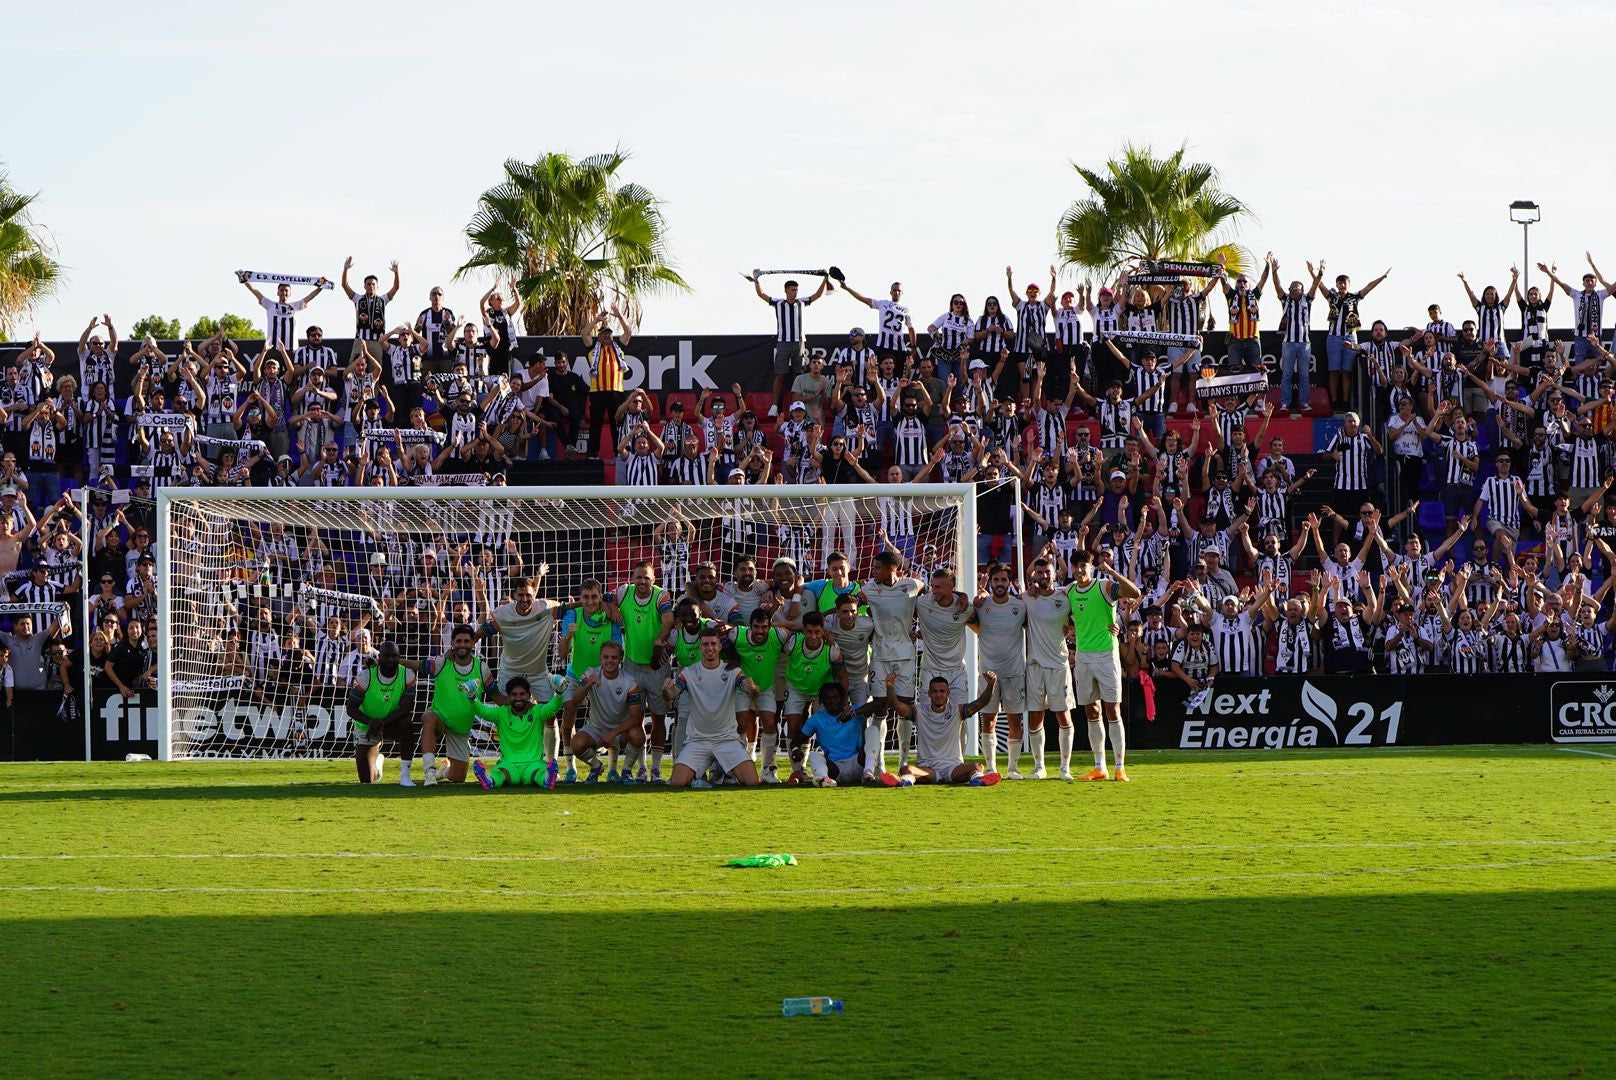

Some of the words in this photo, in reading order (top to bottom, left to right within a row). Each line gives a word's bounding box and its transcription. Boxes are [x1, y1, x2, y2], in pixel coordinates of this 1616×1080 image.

[883, 310, 904, 332] 23
[1210, 385, 1232, 396] ANYS
[1185, 688, 1272, 716] Next
[1179, 718, 1319, 750] Energía
[1344, 701, 1403, 745] 21
